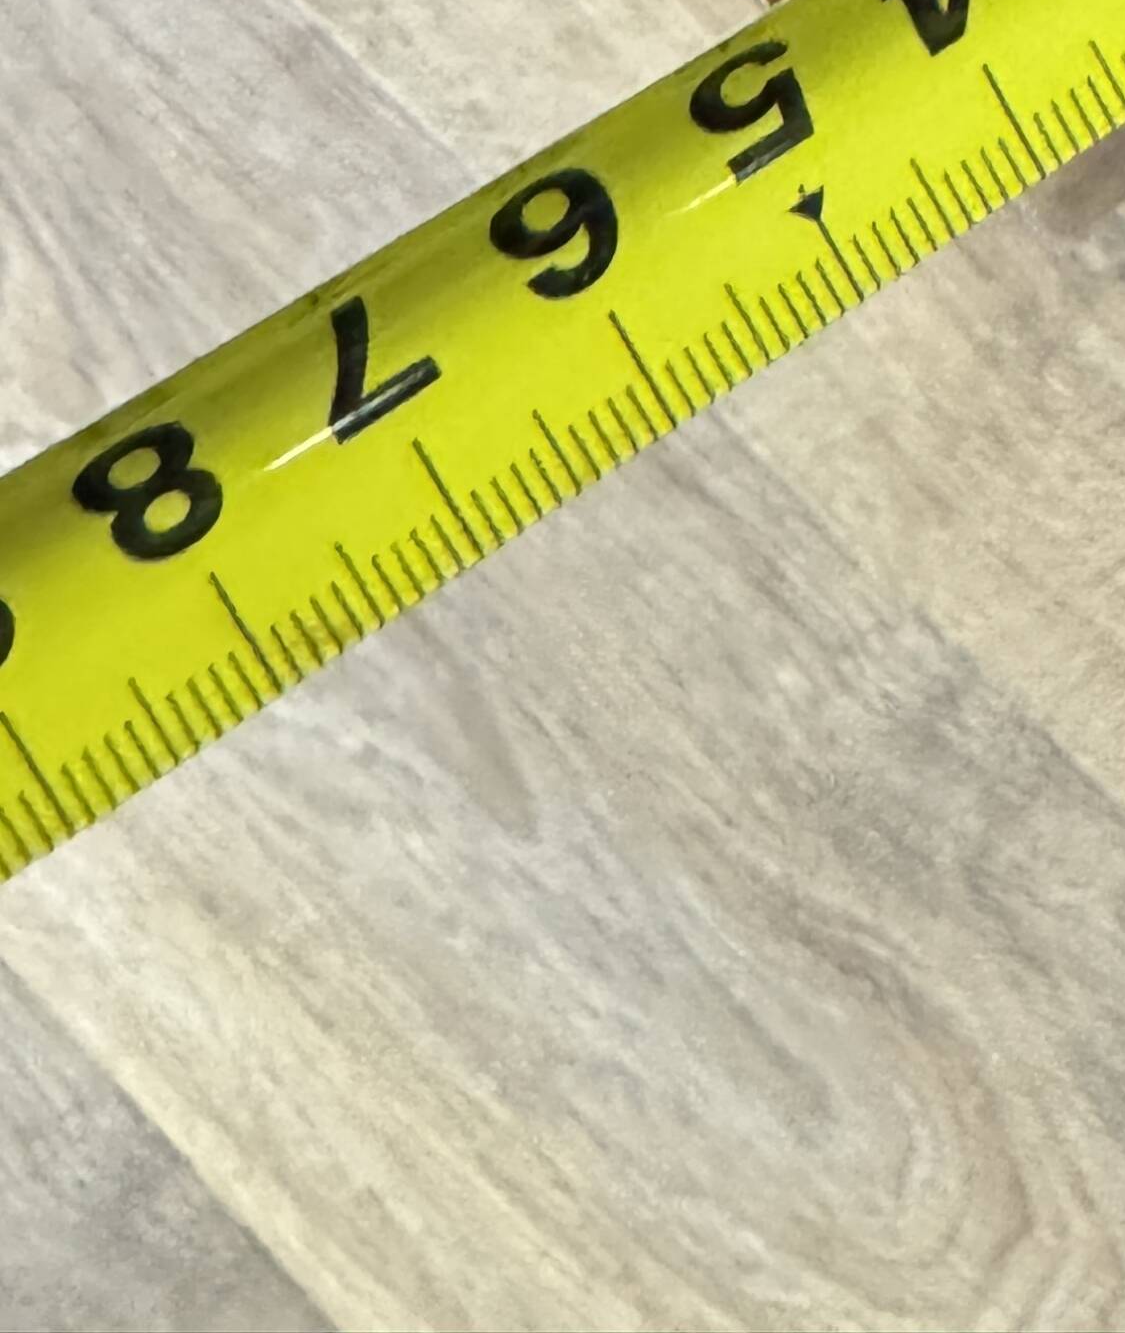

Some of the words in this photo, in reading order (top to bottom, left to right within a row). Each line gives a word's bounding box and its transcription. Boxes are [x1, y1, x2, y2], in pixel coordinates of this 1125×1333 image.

[690, 40, 814, 186] 5
[490, 168, 619, 300] 6
[330, 296, 442, 445] 7
[72, 421, 223, 561] 8
